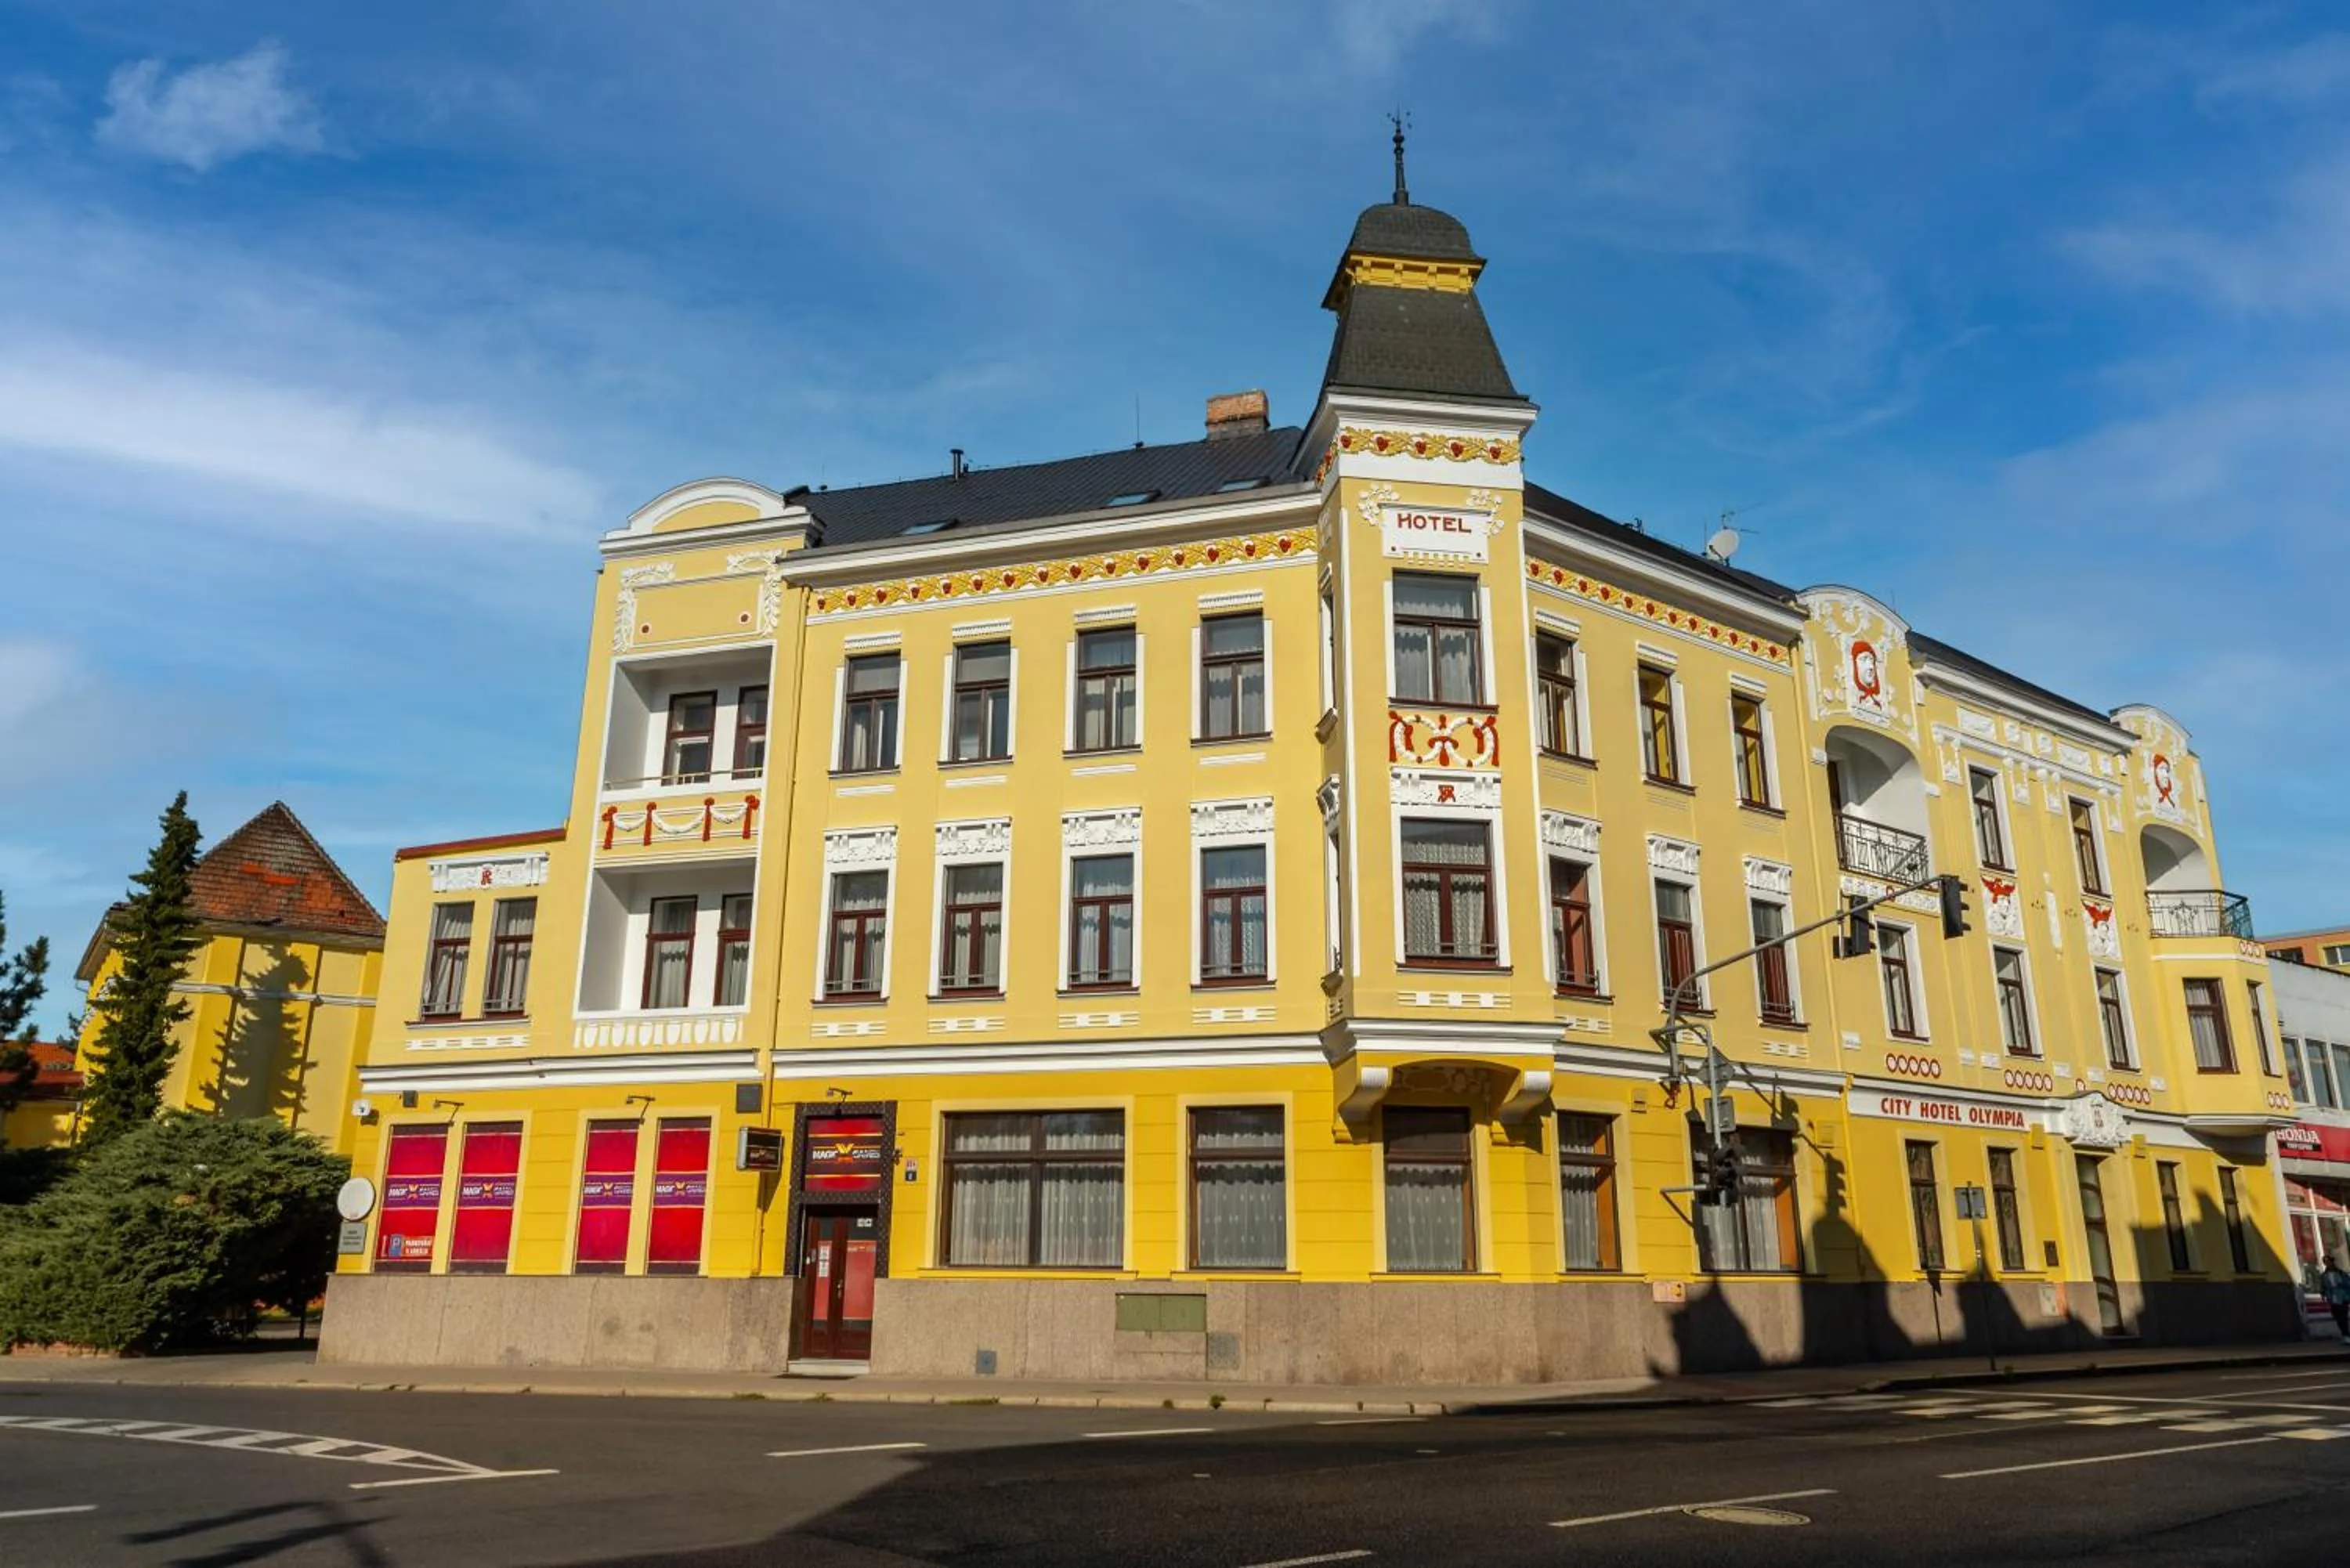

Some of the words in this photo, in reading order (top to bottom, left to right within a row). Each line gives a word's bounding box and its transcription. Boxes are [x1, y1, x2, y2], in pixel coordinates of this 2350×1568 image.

[1397, 513, 1472, 533] HOTEL
[1881, 1097, 1911, 1115] CITY
[1920, 1102, 1961, 1122] HOTEL
[1969, 1107, 2025, 1127] OLYMPIA
[2276, 1129, 2321, 1143] HONDA
